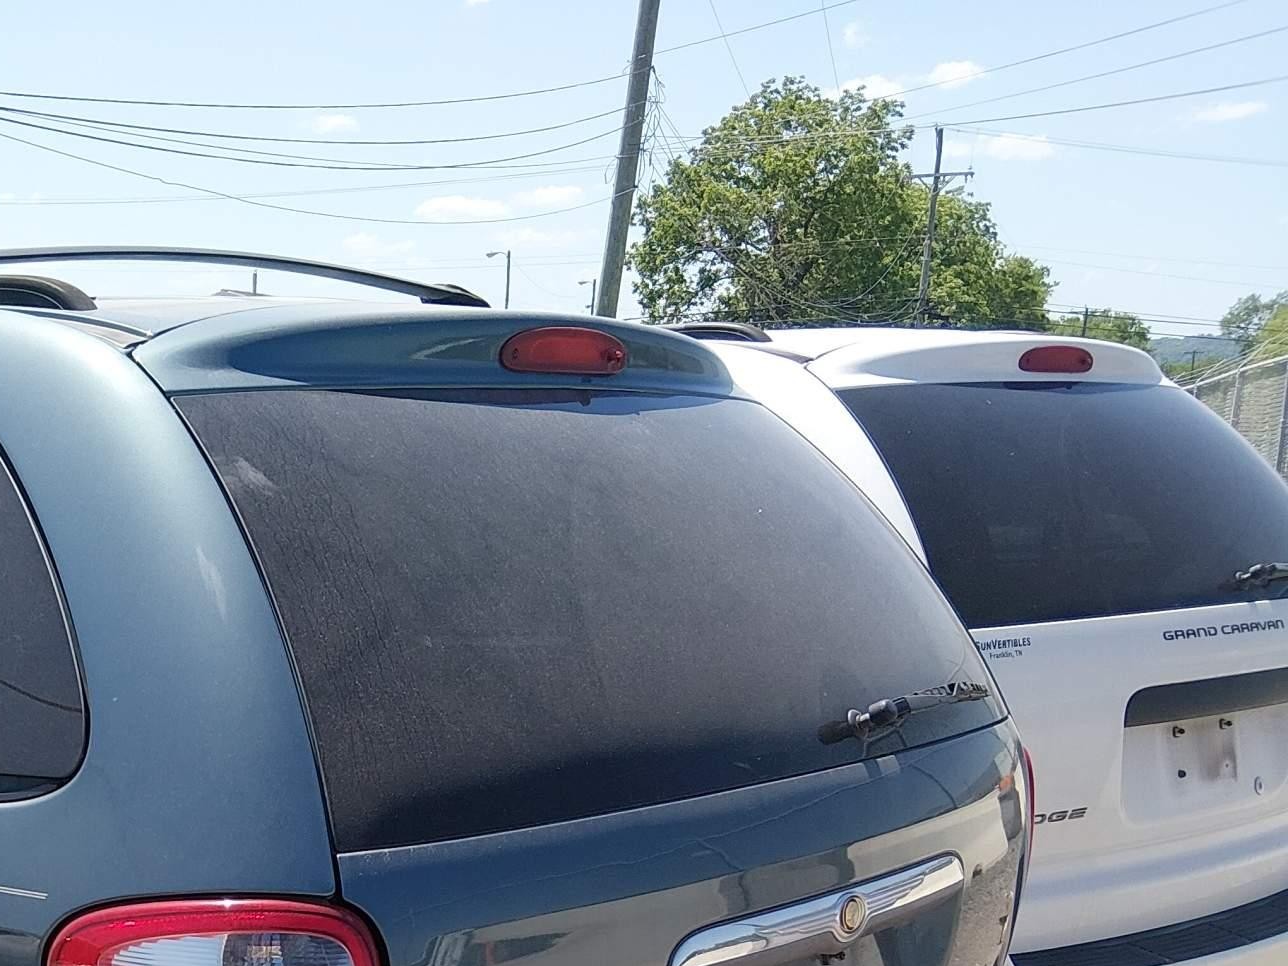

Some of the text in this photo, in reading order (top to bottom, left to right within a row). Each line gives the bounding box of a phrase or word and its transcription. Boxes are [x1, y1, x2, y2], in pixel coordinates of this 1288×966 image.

[1162, 619, 1285, 641] GRAND CARAVAN
[1015, 649, 1023, 657] TN
